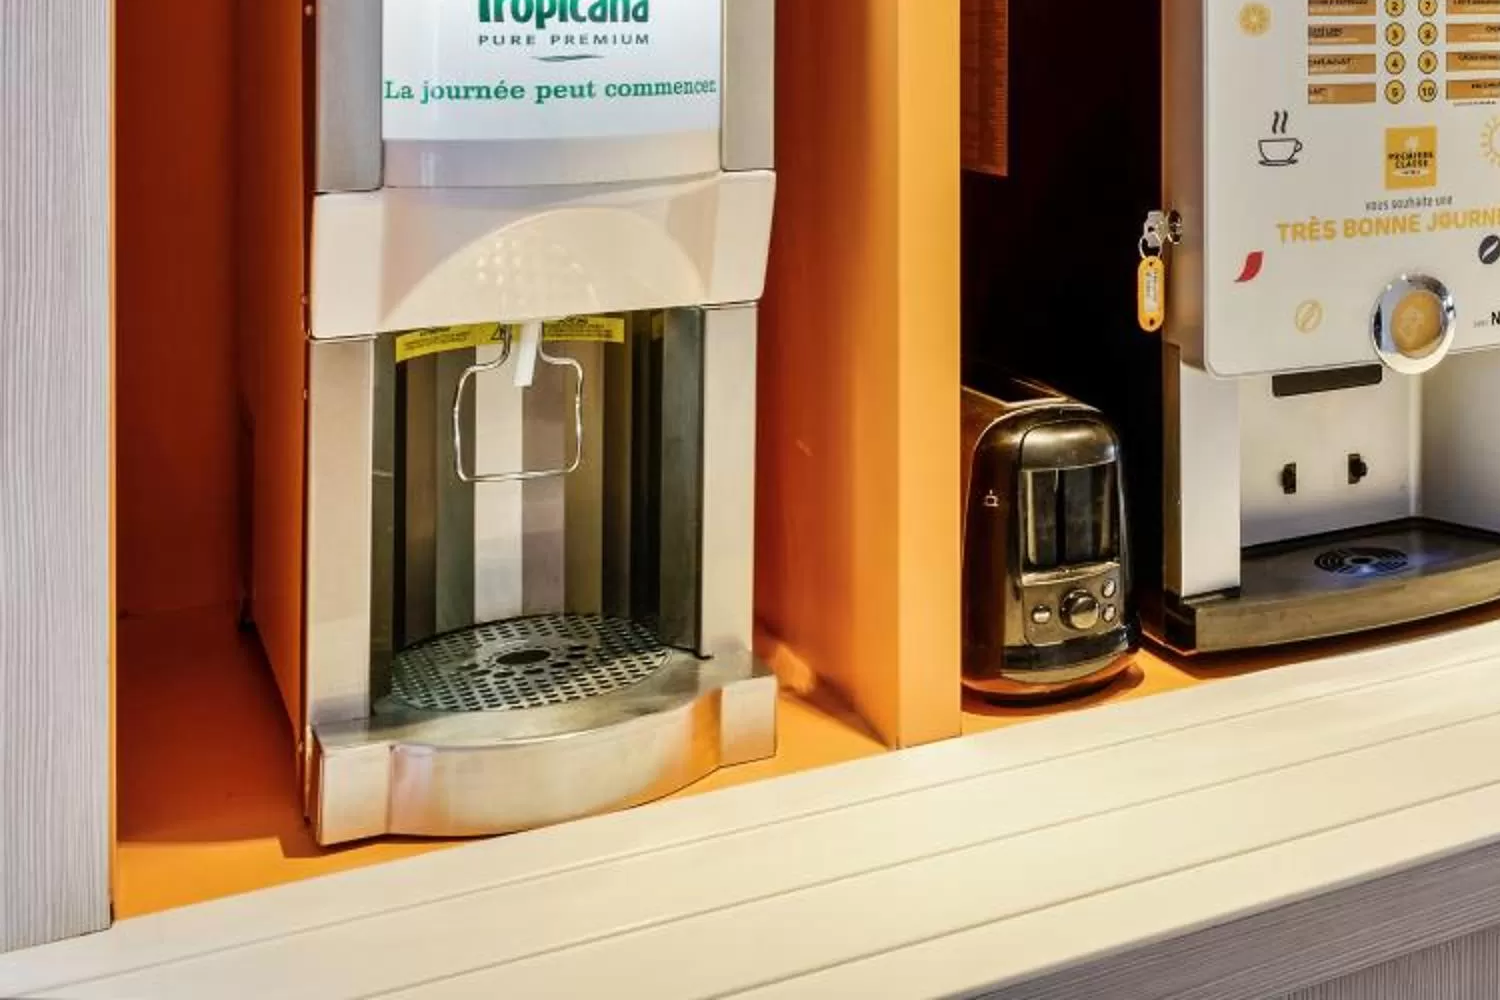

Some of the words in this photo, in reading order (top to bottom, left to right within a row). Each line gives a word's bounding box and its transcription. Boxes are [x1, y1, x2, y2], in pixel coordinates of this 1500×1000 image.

[478, 34, 537, 45] PURE
[550, 33, 650, 45] PREMIUM
[384, 80, 414, 99] La
[420, 79, 525, 104] journée
[534, 80, 596, 104] peut
[1276, 216, 1337, 242] TRÈS
[1343, 214, 1421, 238] BONNE
